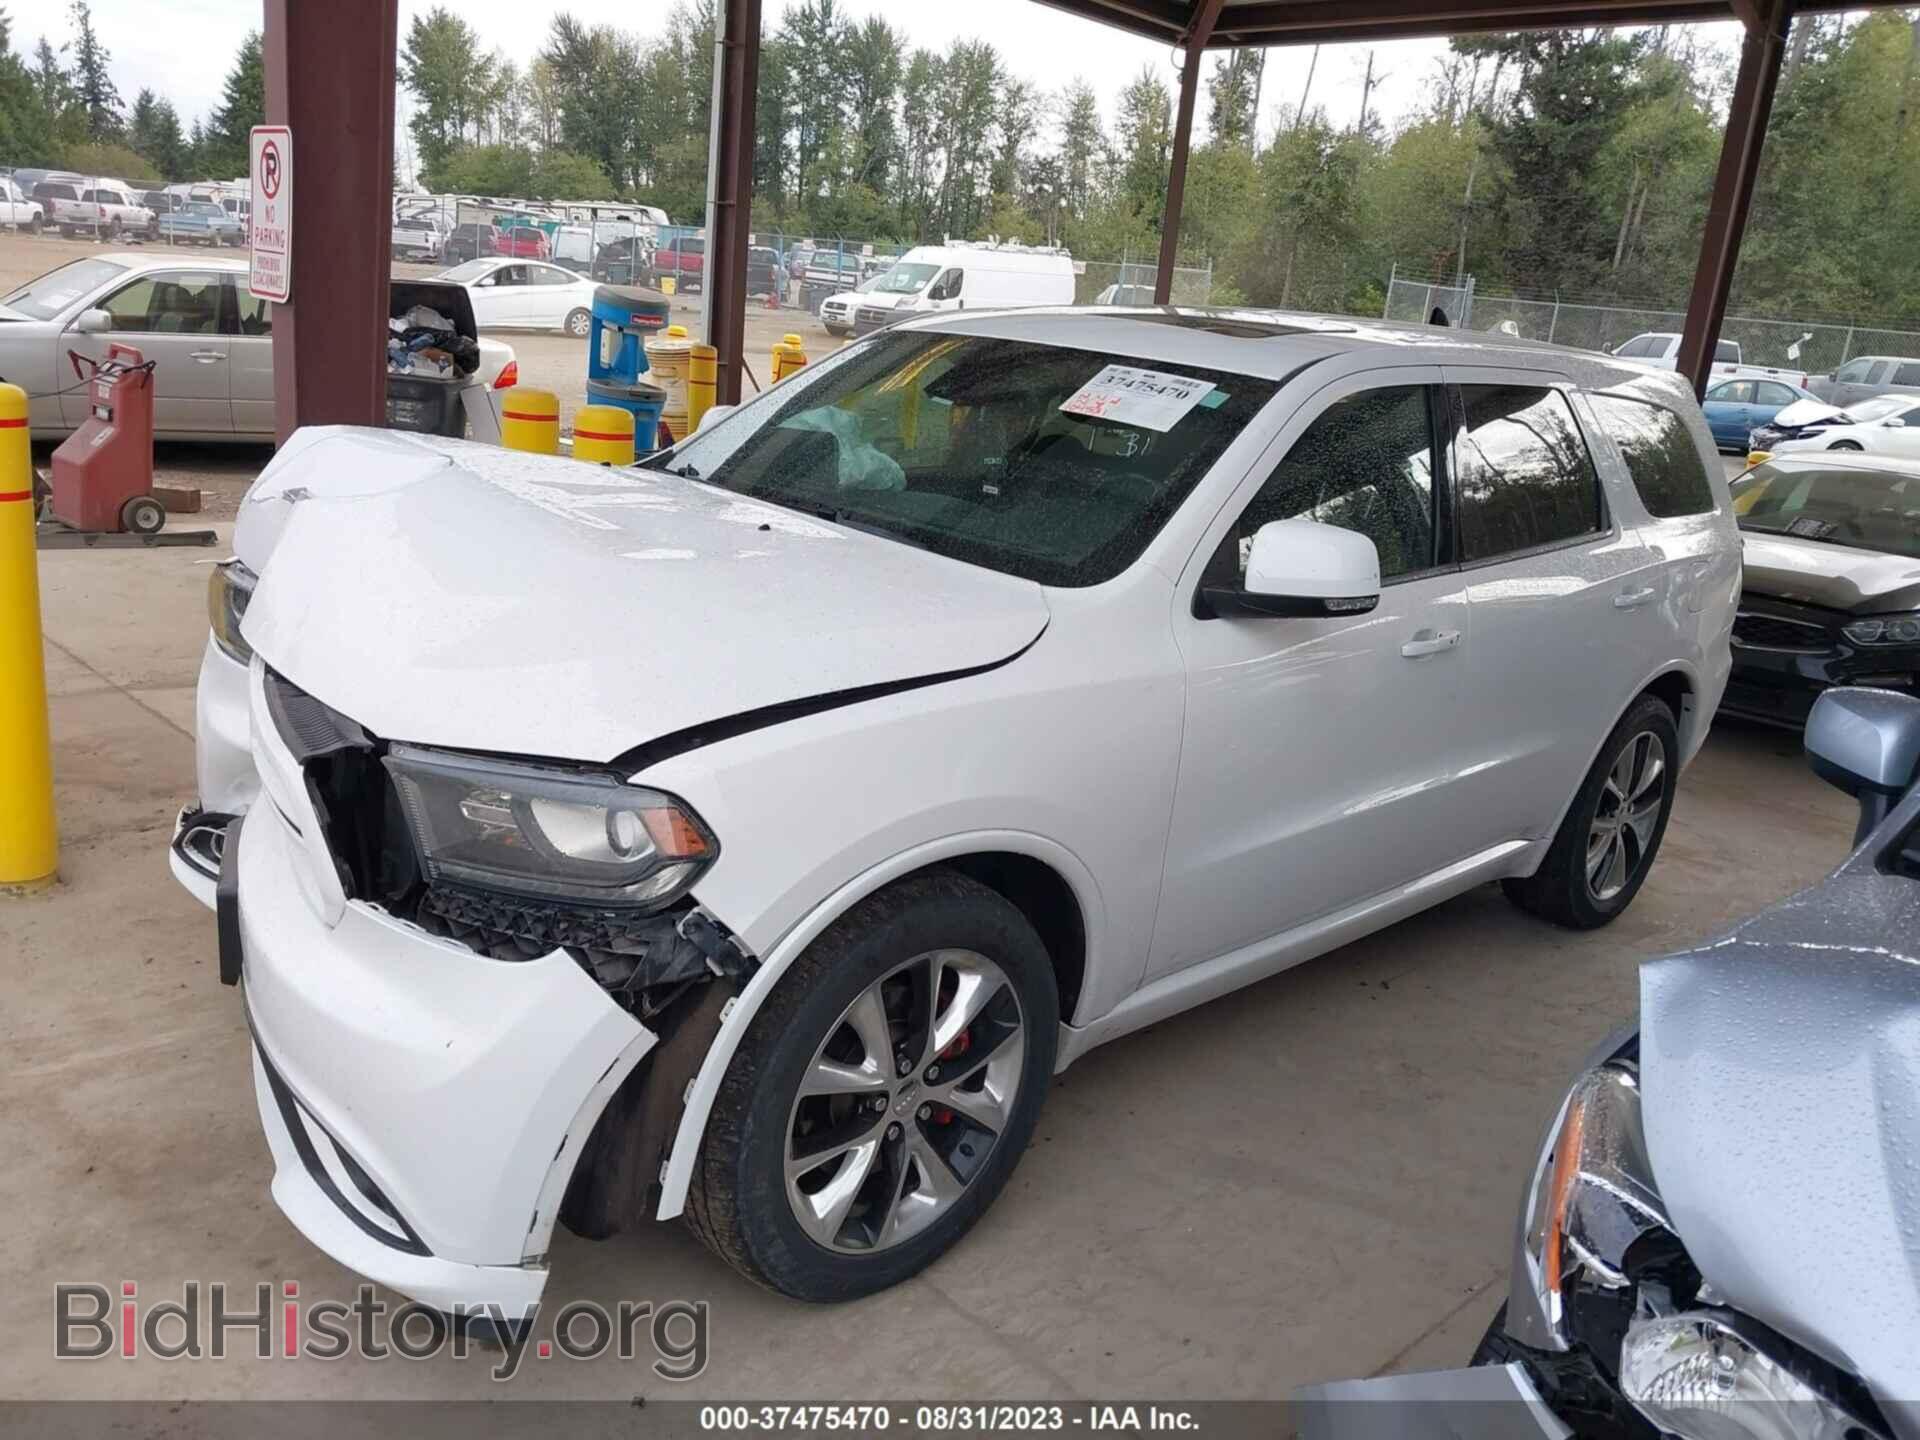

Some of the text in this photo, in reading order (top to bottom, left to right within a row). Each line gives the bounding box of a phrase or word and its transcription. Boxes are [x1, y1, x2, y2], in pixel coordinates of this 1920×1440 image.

[264, 204, 275, 225] NO
[254, 226, 286, 249] PARKING
[1103, 375, 1190, 401] 37475470
